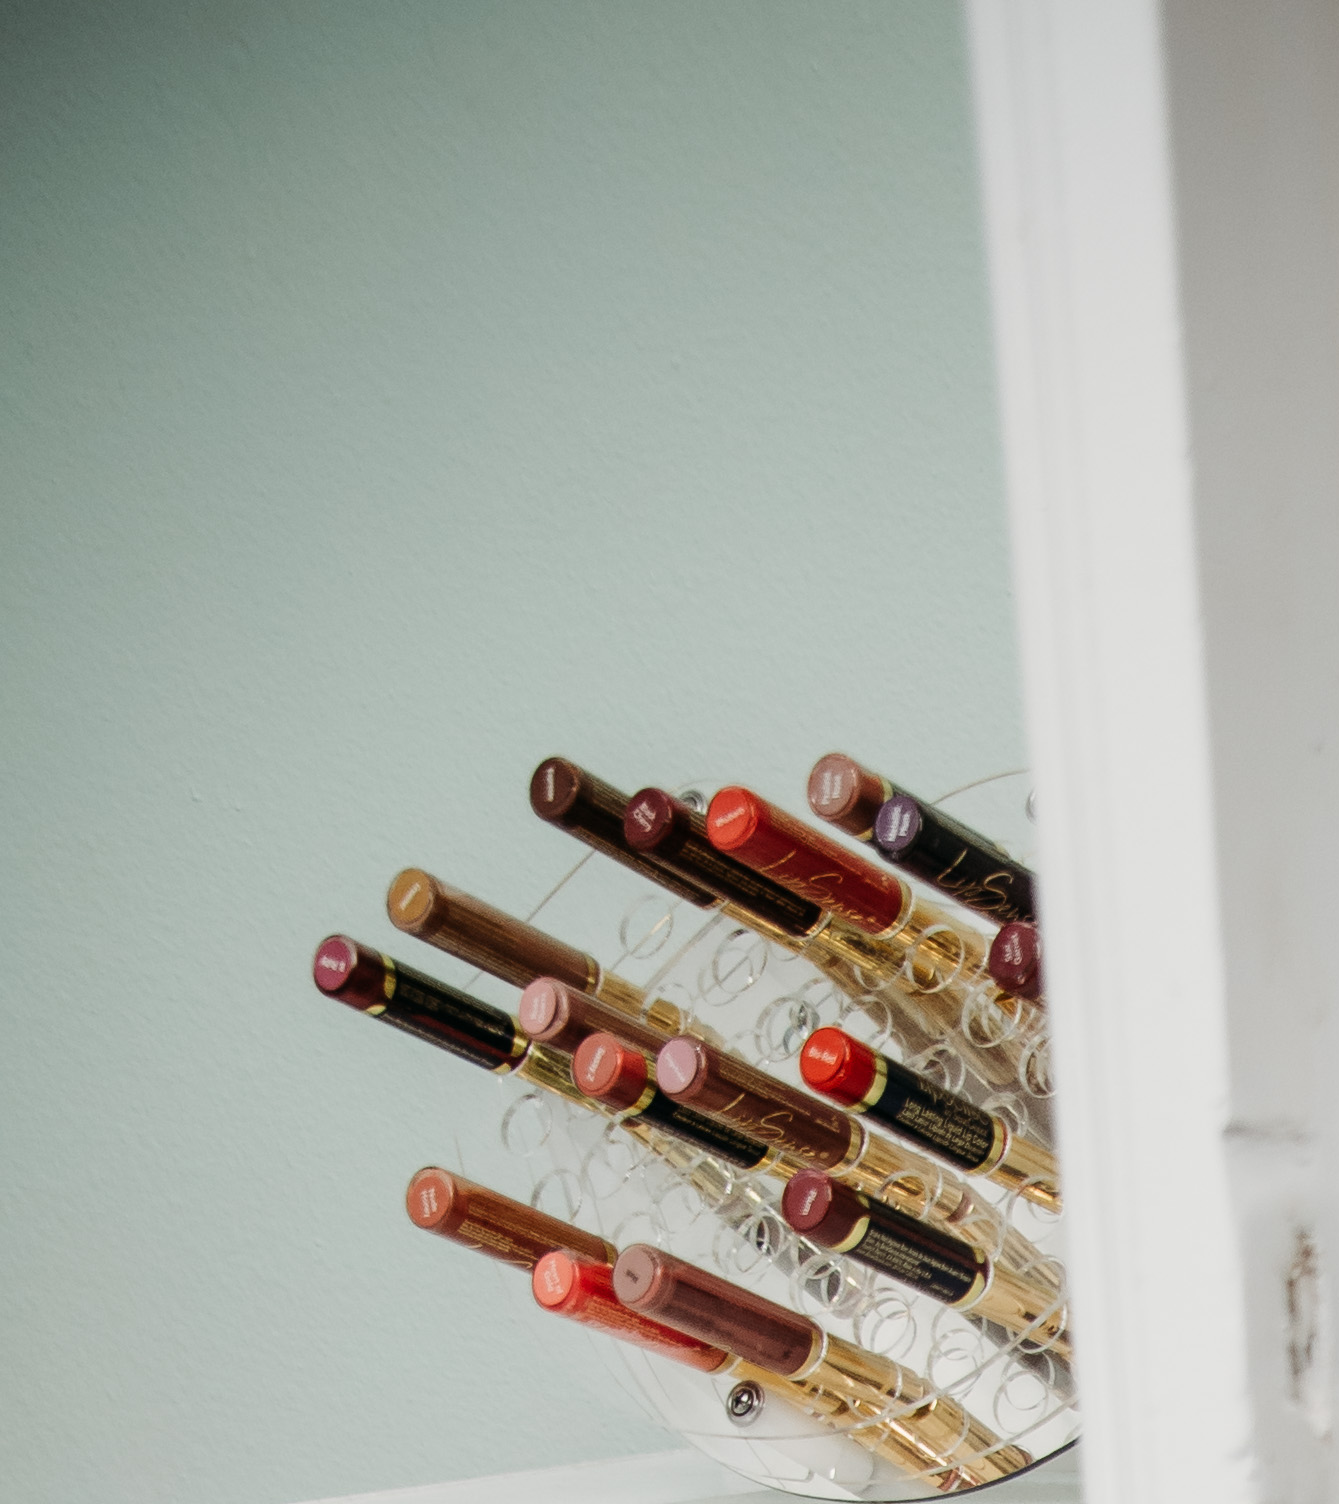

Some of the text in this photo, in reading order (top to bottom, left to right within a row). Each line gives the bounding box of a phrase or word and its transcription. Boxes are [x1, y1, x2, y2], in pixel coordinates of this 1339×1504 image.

[920, 1109, 943, 1125] Lasting
[943, 1119, 963, 1135] Liquid
[801, 1188, 818, 1216] Plum
